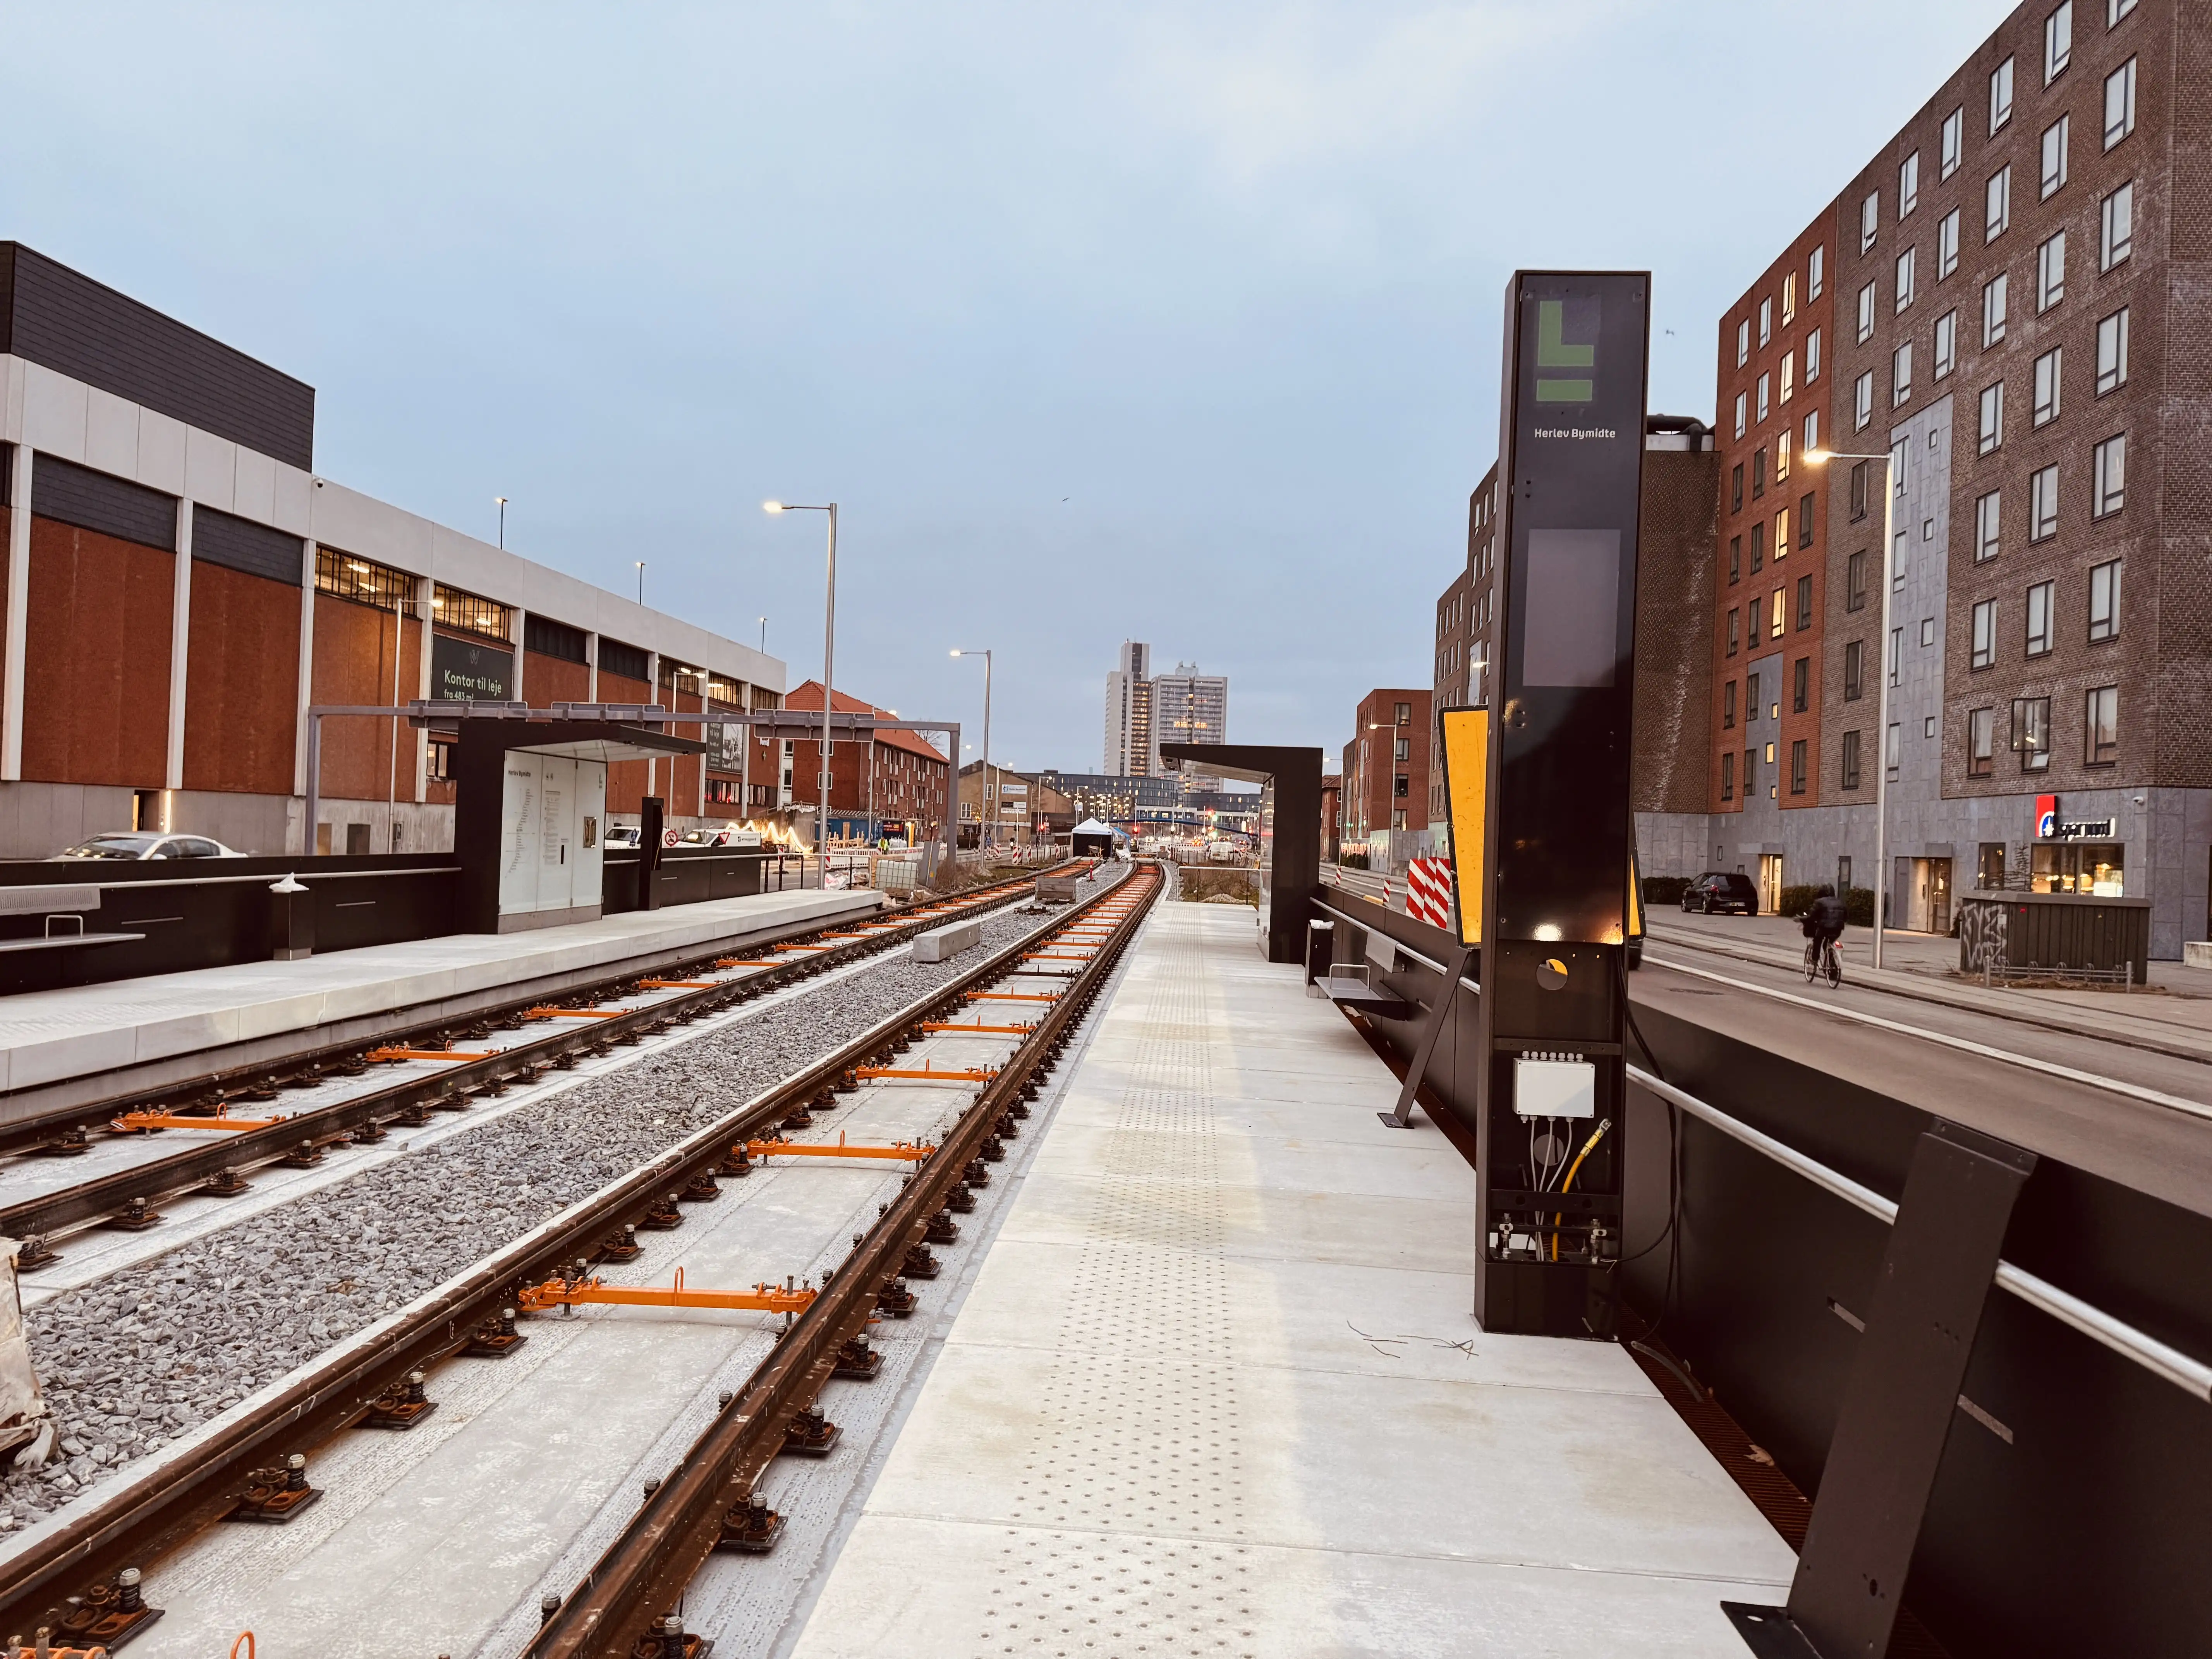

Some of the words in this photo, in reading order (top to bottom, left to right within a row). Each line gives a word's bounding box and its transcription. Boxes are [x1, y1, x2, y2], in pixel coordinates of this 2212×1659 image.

[1534, 428, 1569, 438] Herlev
[1571, 427, 1616, 440] Bymidte
[445, 669, 475, 689] Kontor
[477, 676, 486, 691] til
[488, 678, 501, 697] leje
[444, 689, 453, 699] fra
[454, 690, 465, 701] 483
